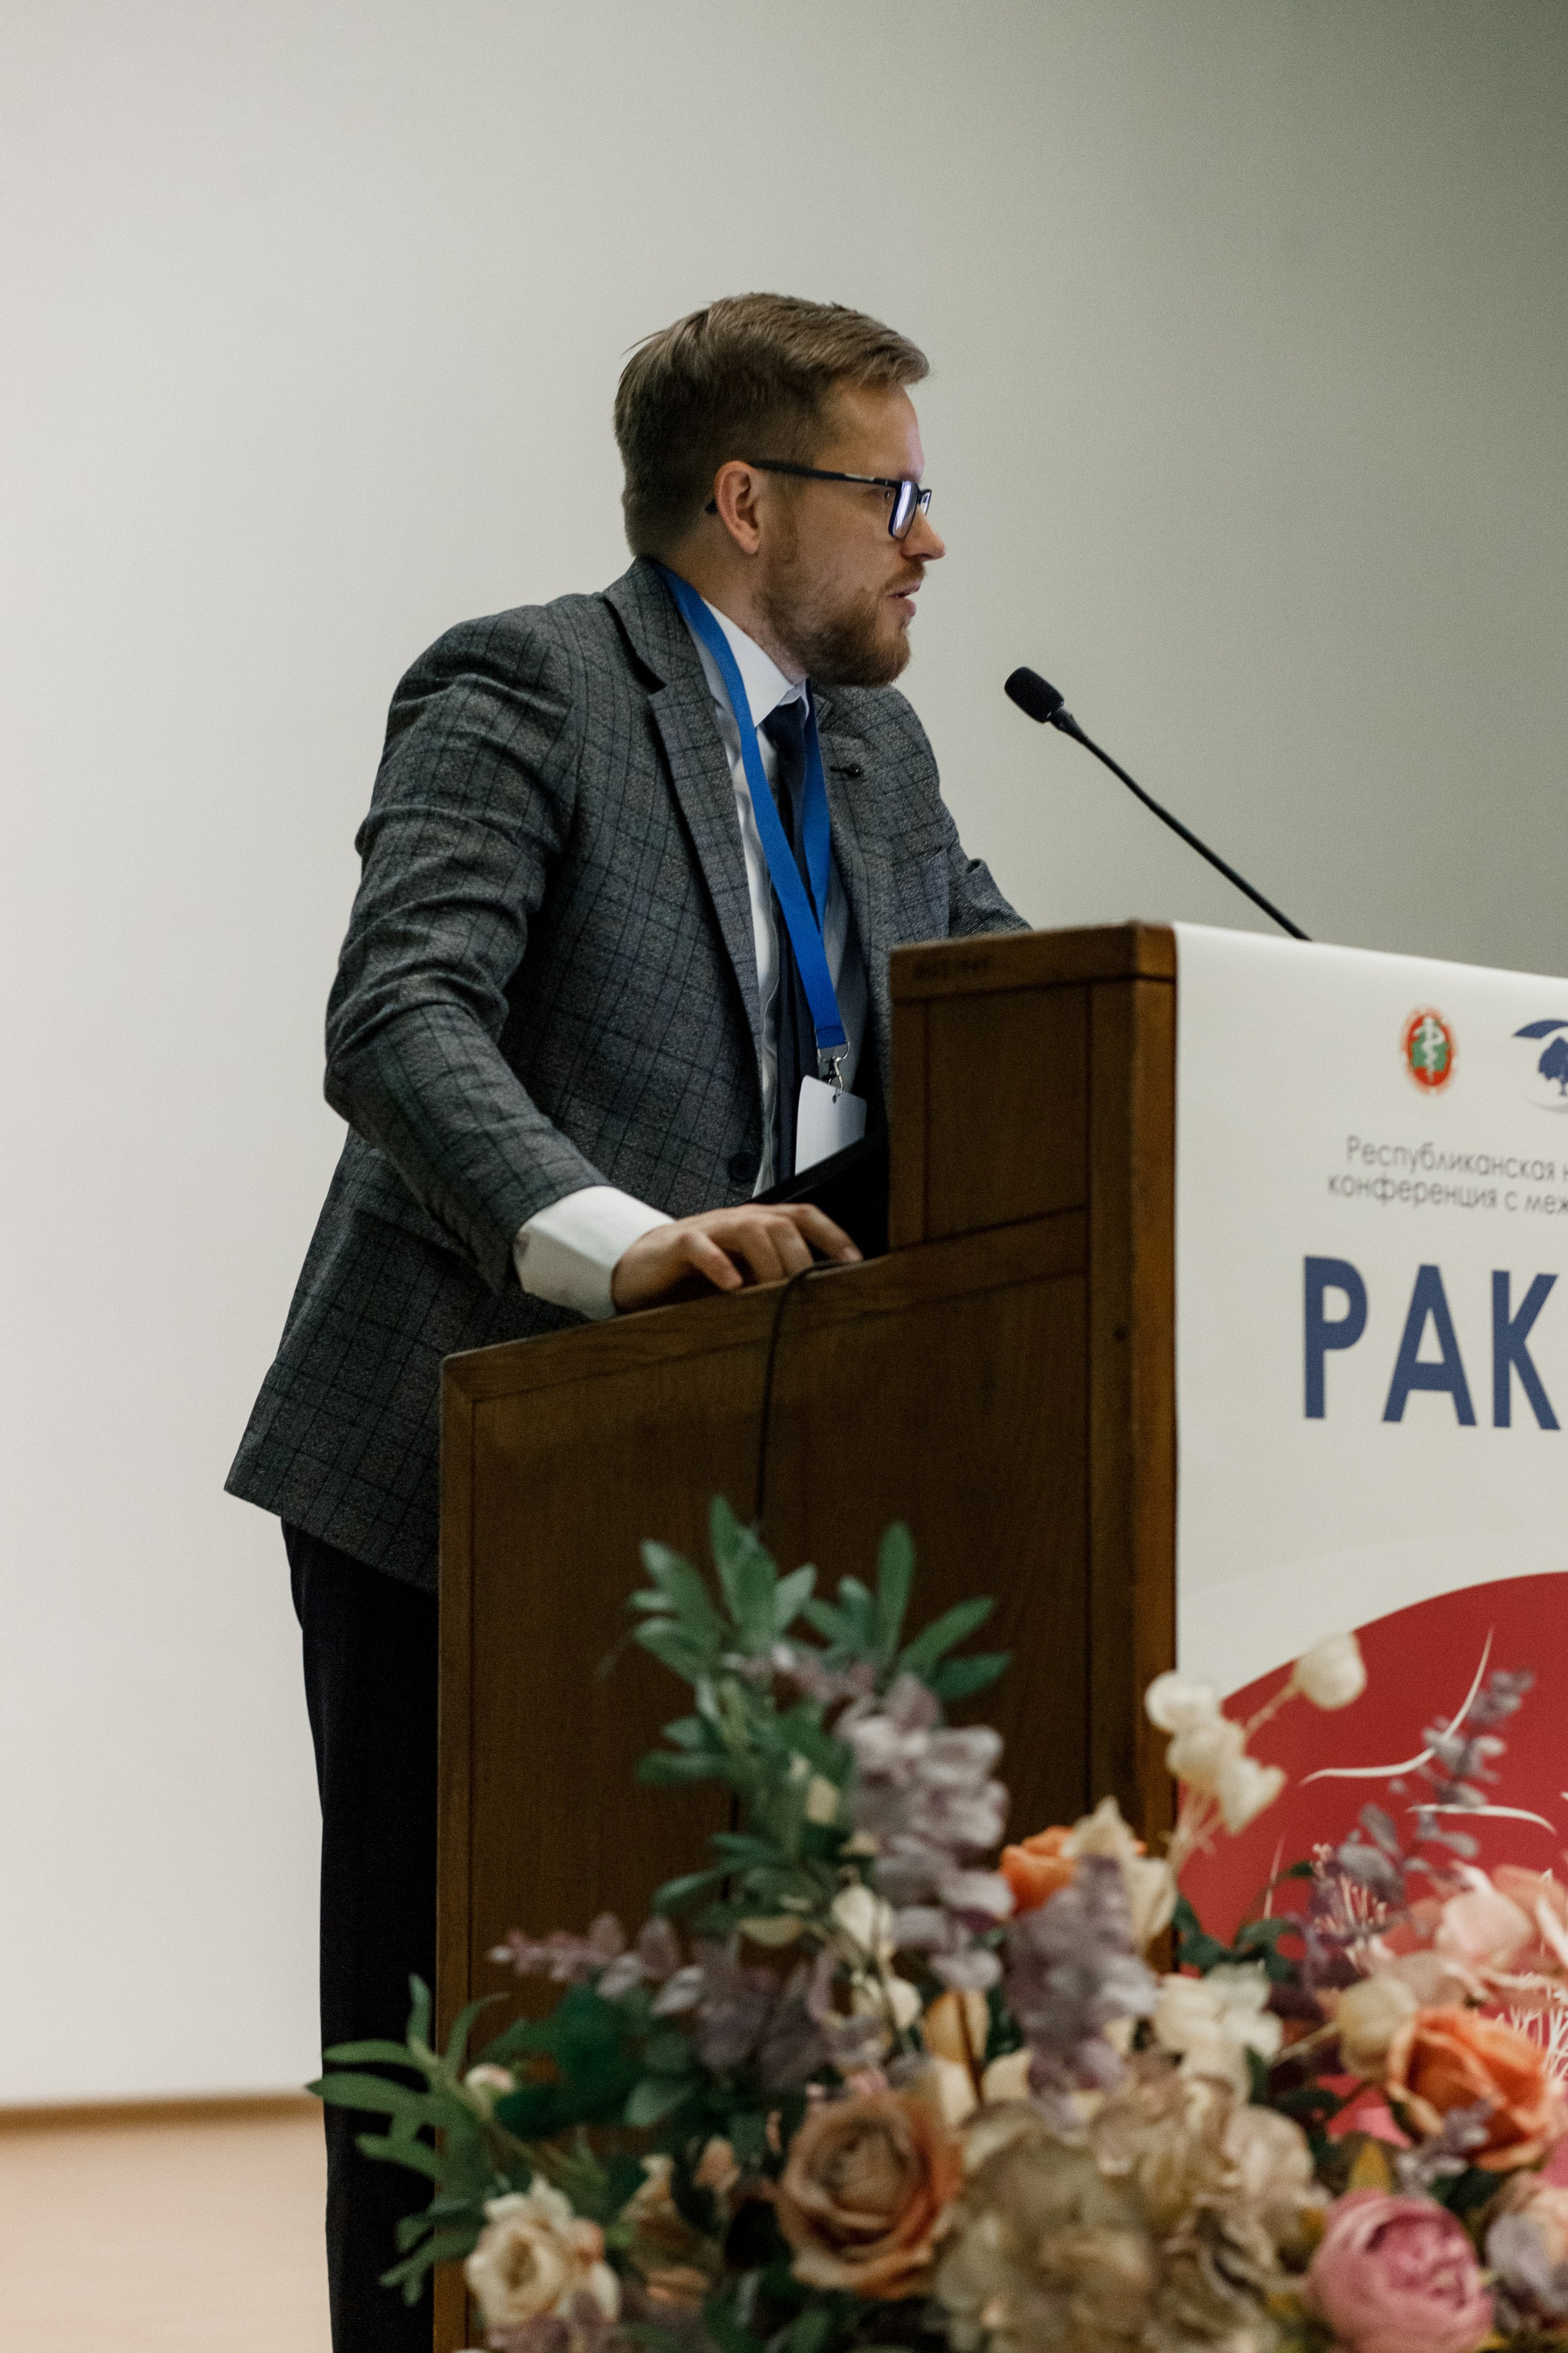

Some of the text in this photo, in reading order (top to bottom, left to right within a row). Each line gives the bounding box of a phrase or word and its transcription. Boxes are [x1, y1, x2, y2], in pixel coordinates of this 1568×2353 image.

[1346, 1134, 1555, 1181] Республиканская
[1327, 1173, 1497, 1209] конференция
[1504, 1190, 1519, 1212] с
[1303, 1253, 1561, 1432] РАК
